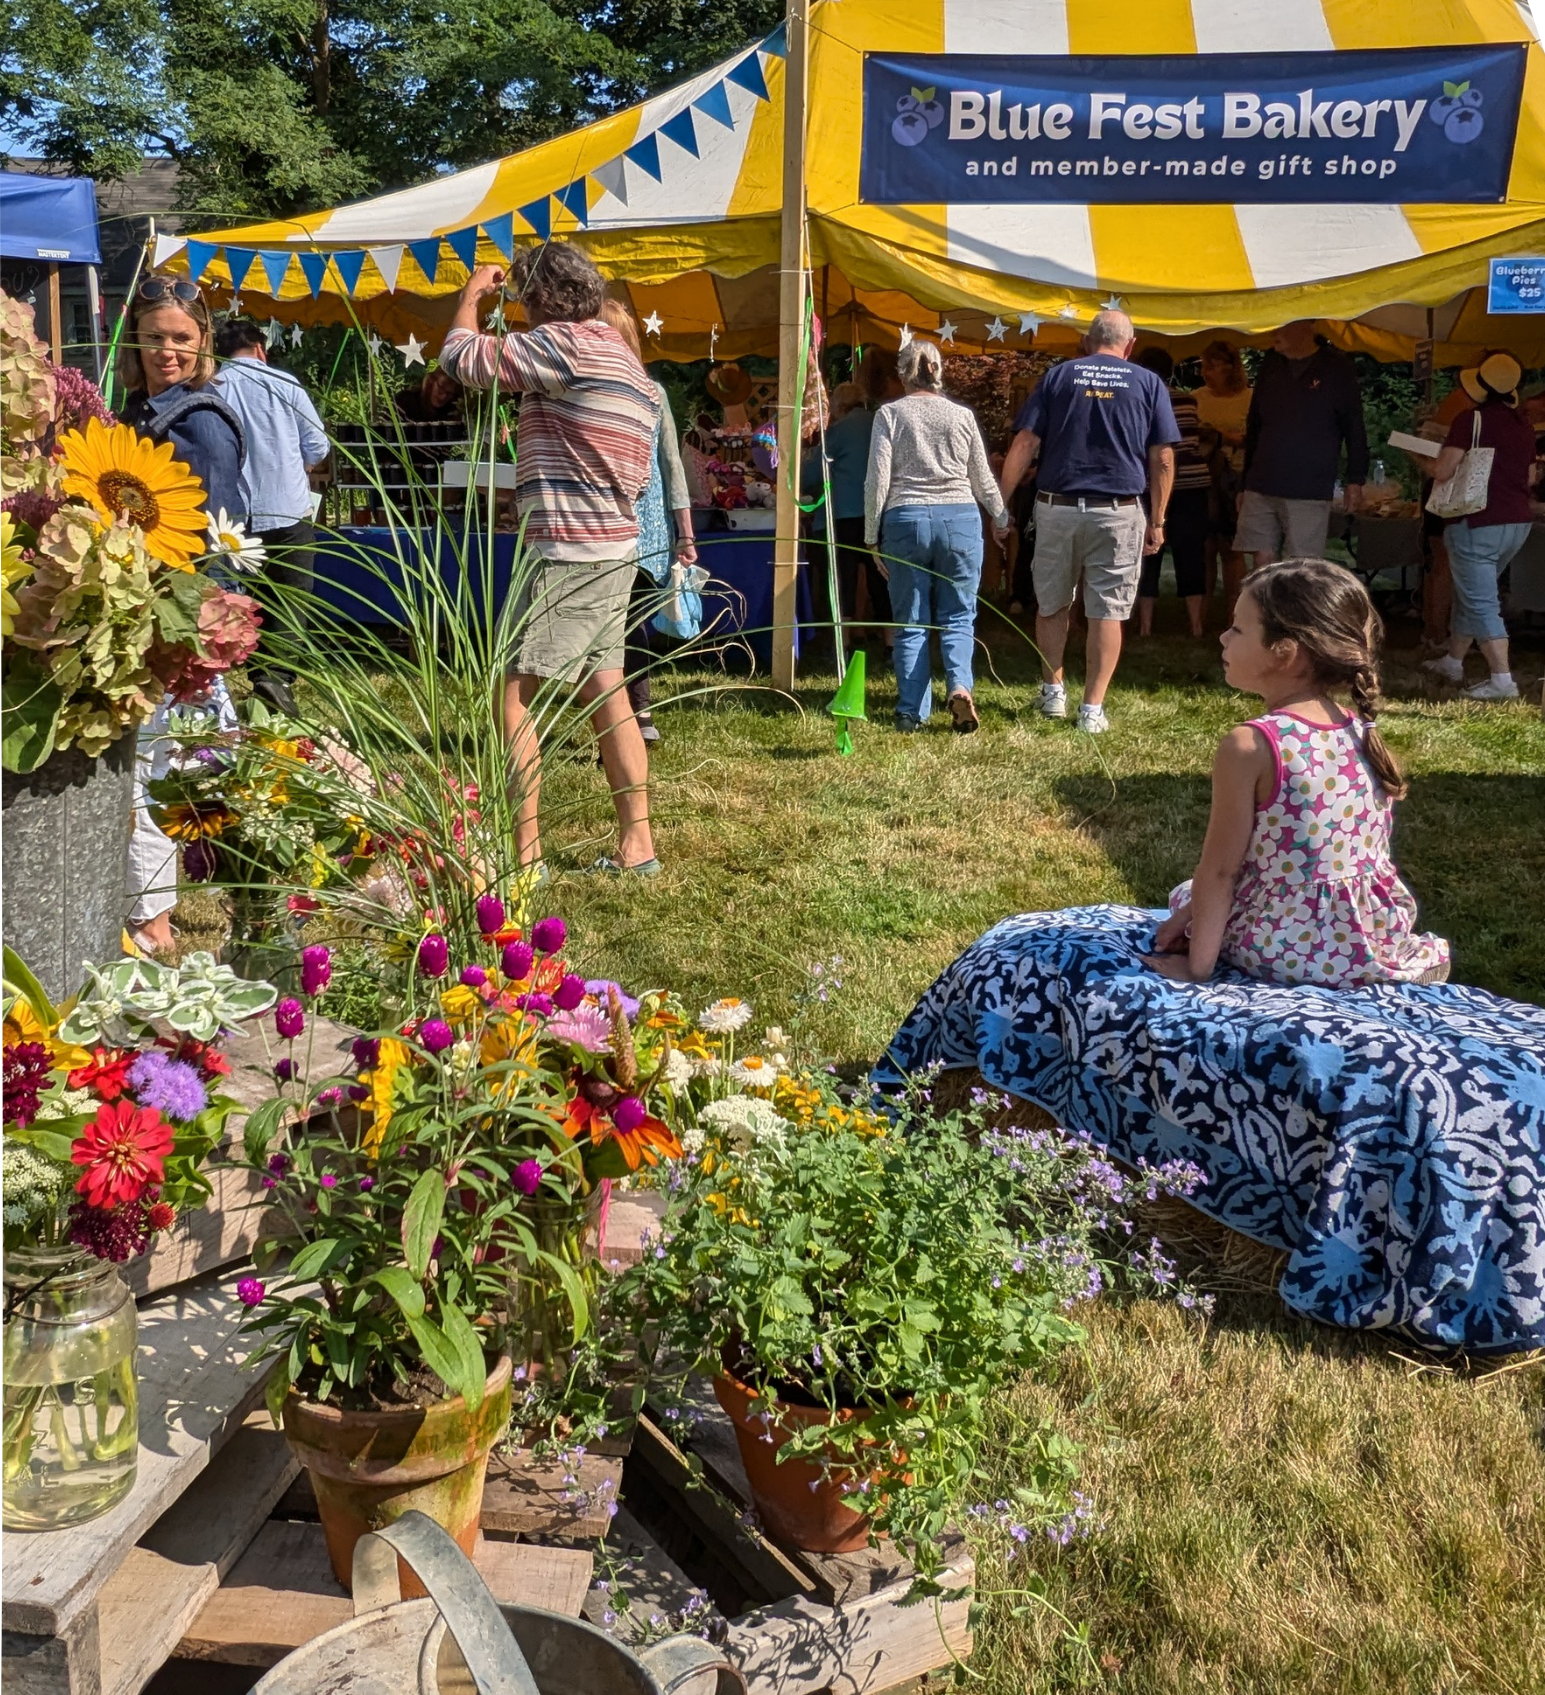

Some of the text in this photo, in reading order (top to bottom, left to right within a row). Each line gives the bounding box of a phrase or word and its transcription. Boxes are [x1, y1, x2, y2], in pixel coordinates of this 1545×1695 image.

[948, 89, 1427, 152] Blue Fest Bakery
[965, 155, 1397, 180] and member-made gift shop
[1512, 275, 1536, 285] Pies
[1518, 287, 1541, 298] $25
[1073, 378, 1090, 386] Help
[1109, 380, 1129, 388] Lives.
[1085, 390, 1115, 399] RPEAT.
